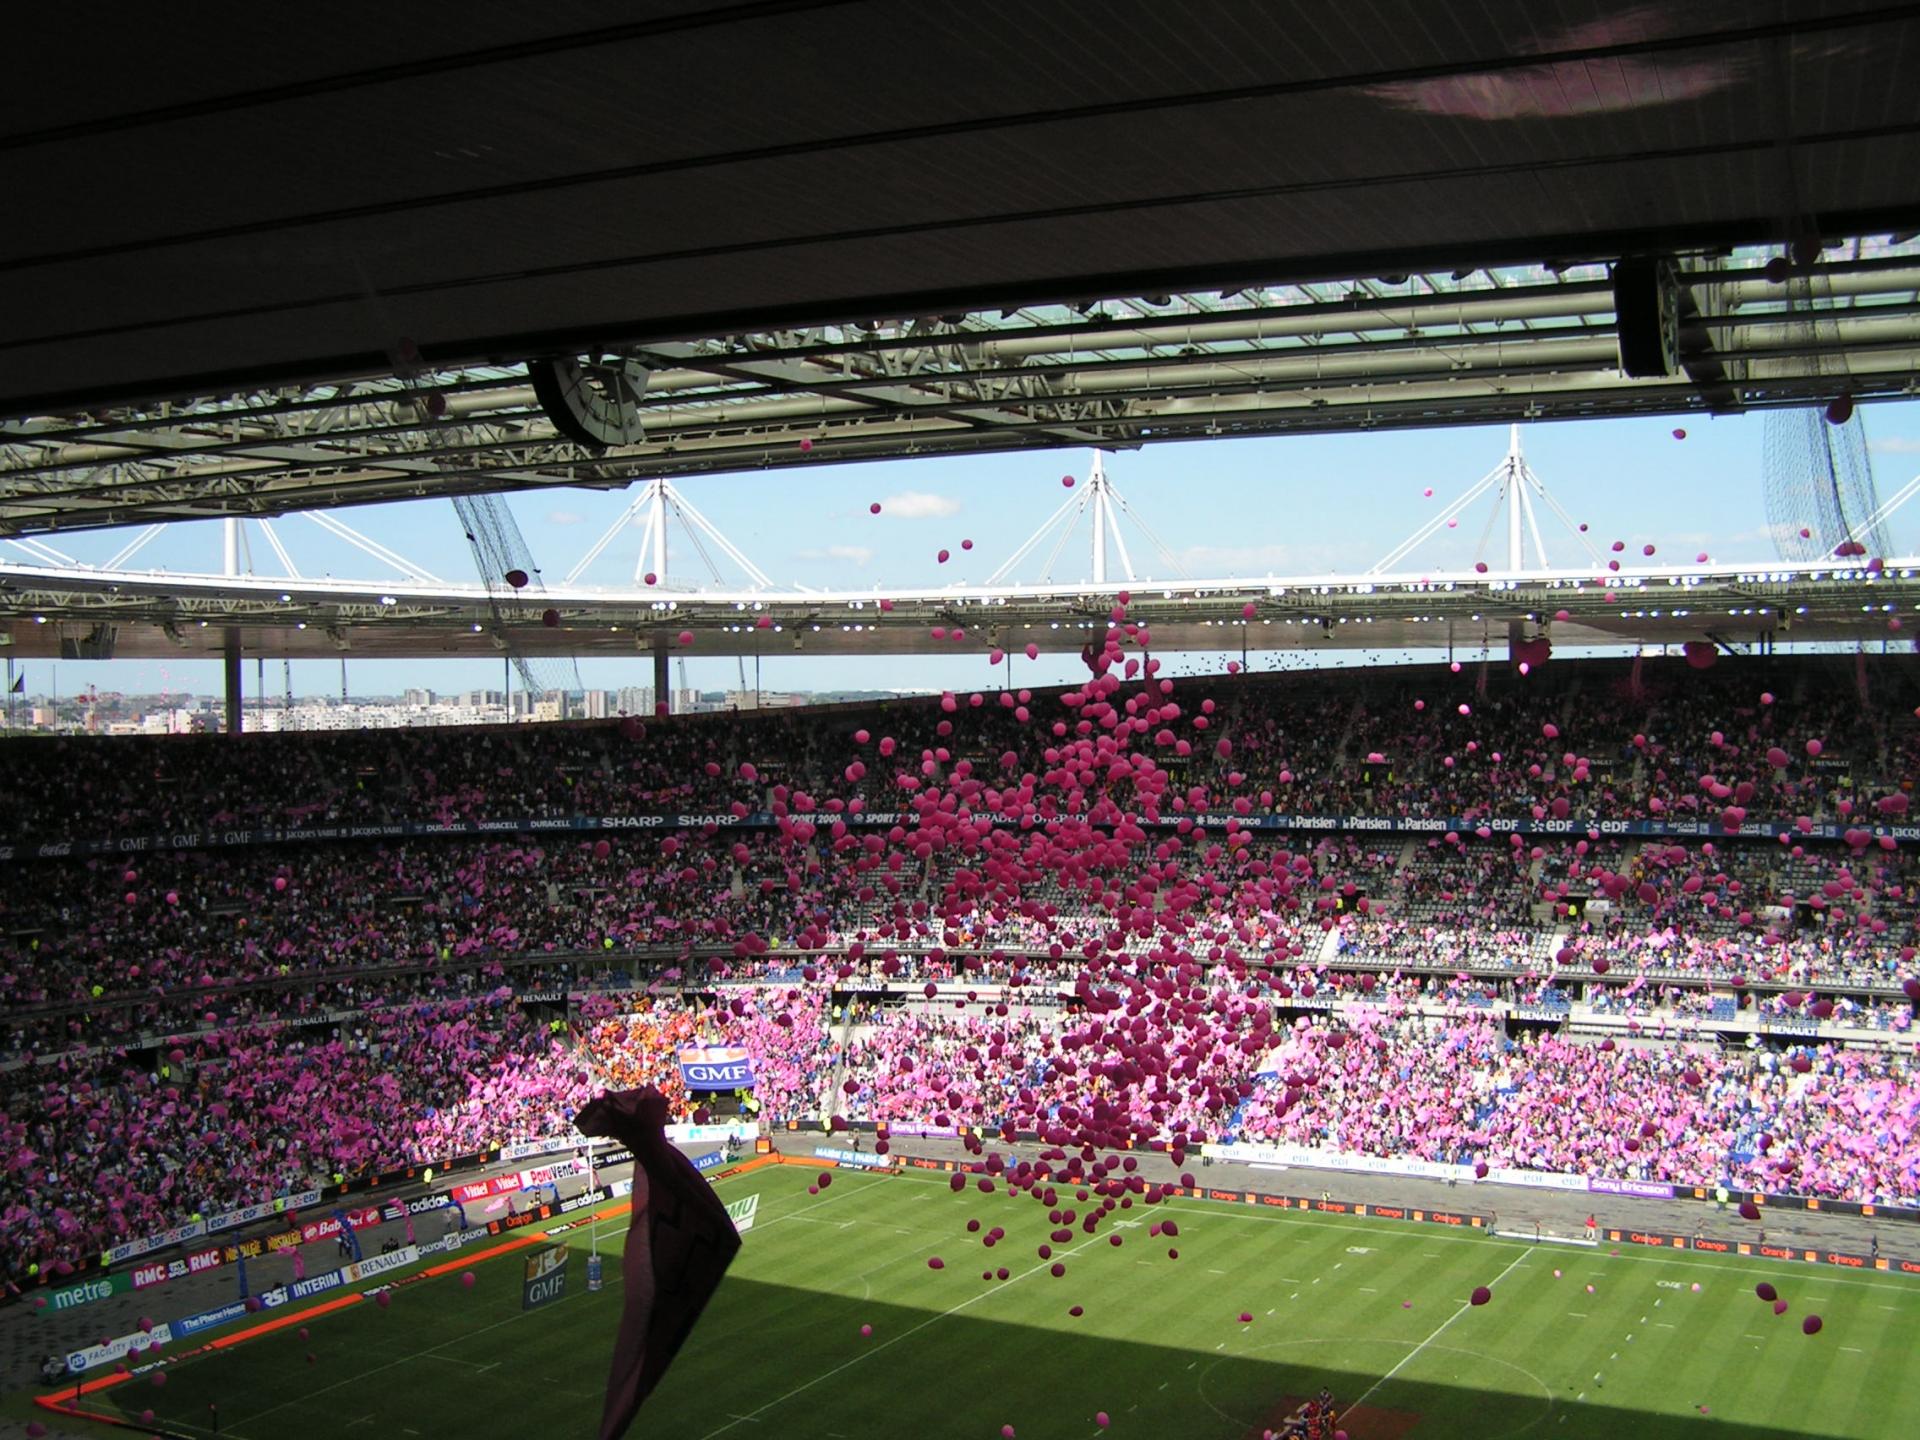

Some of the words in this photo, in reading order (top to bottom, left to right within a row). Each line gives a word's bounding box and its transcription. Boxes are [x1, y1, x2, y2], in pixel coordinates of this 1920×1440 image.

[530, 819, 571, 828] DURACELL
[602, 816, 664, 828] SHARP
[678, 815, 740, 826] SHARP
[817, 814, 842, 825] 2000
[866, 813, 895, 824] SPORT
[895, 813, 920, 824] 200
[1295, 815, 1337, 829] Parisien
[1350, 816, 1391, 830] Parisien
[1404, 817, 1447, 831] Parisien
[479, 821, 519, 830] DURACELL
[120, 837, 148, 851] GMF
[173, 834, 201, 848] GMF
[224, 831, 251, 845] GMF
[843, 983, 883, 992] RENAULT
[523, 992, 562, 1003] RENAULT
[1292, 1000, 1332, 1009] RENAULT
[292, 1015, 327, 1026] RENAULT
[1519, 1011, 1563, 1021] RENAULT
[1769, 1025, 1818, 1036] RENAULT
[688, 1065, 747, 1081] GMF
[606, 1151, 634, 1163] UNIVE
[914, 1159, 938, 1169] Orange
[495, 1174, 520, 1191] Vittel
[1592, 1179, 1619, 1193] Sony
[1621, 1182, 1669, 1196] Ericsson
[463, 1185, 489, 1199] Vittel
[1211, 1191, 1237, 1201] Orange
[410, 1194, 450, 1214] adidas
[727, 1196, 756, 1218] MU
[1264, 1196, 1292, 1207] Orange
[1317, 1202, 1345, 1212] Orange
[1375, 1207, 1404, 1218] Orange
[1432, 1212, 1462, 1224] Orange
[505, 1213, 534, 1228] Orange
[1631, 1233, 1663, 1245] Orange
[1696, 1239, 1728, 1252] Orange
[1760, 1245, 1795, 1257] Orange
[189, 1249, 221, 1272] RMC
[360, 1250, 408, 1275] RENAULT
[1828, 1252, 1864, 1266] Orange
[134, 1267, 167, 1287] RMC
[292, 1271, 341, 1298] INTERIM
[530, 1273, 564, 1304] GMF
[183, 1319, 199, 1330] The
[88, 1342, 127, 1361] FACILITY
[129, 1329, 170, 1350] SERVCES
